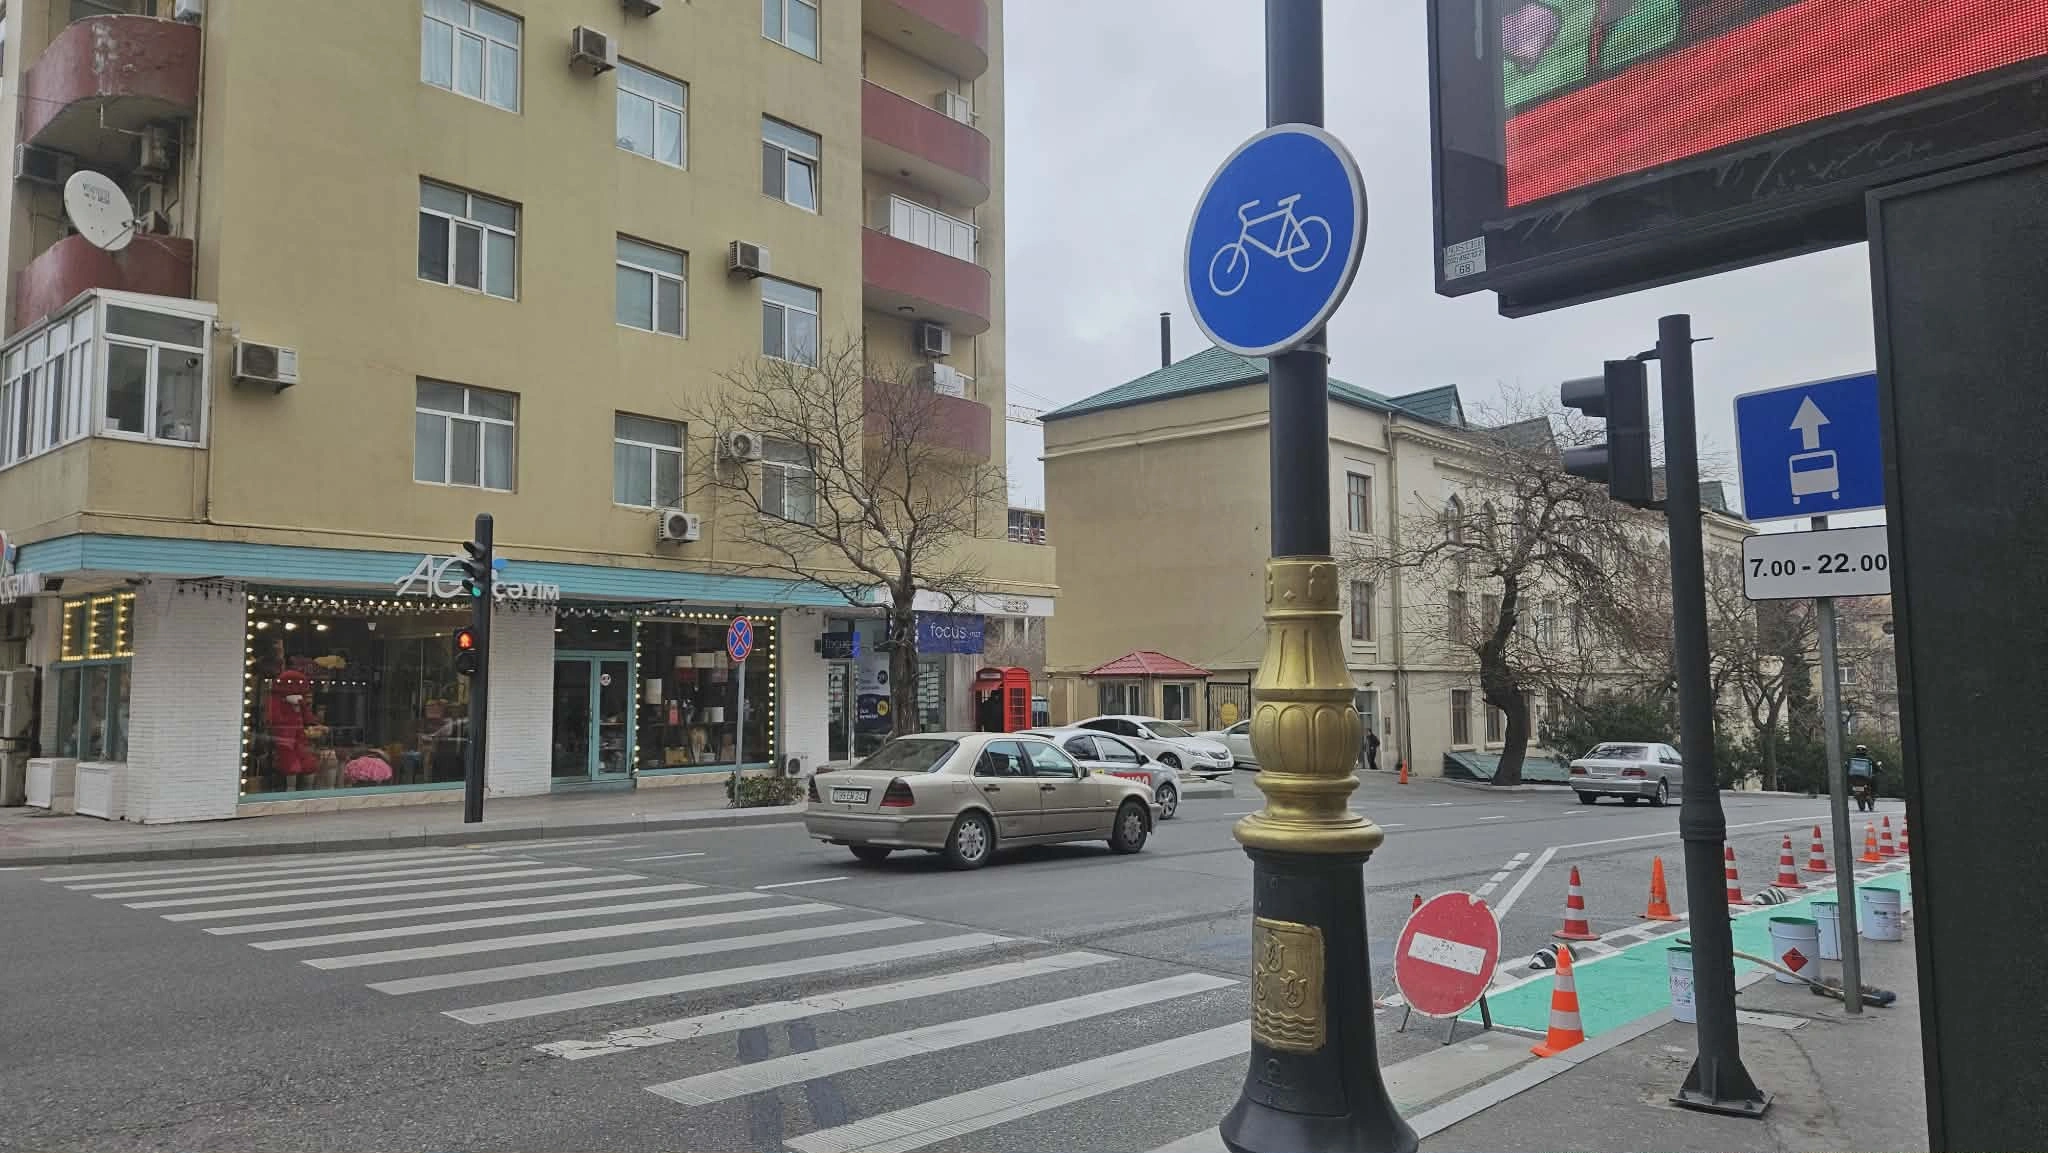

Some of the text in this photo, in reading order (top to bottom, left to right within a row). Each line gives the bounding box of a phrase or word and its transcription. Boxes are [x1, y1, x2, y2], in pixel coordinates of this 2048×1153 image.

[1749, 558, 1796, 578] 7.00
[1817, 552, 1888, 574] 22.00
[929, 621, 968, 641] focus
